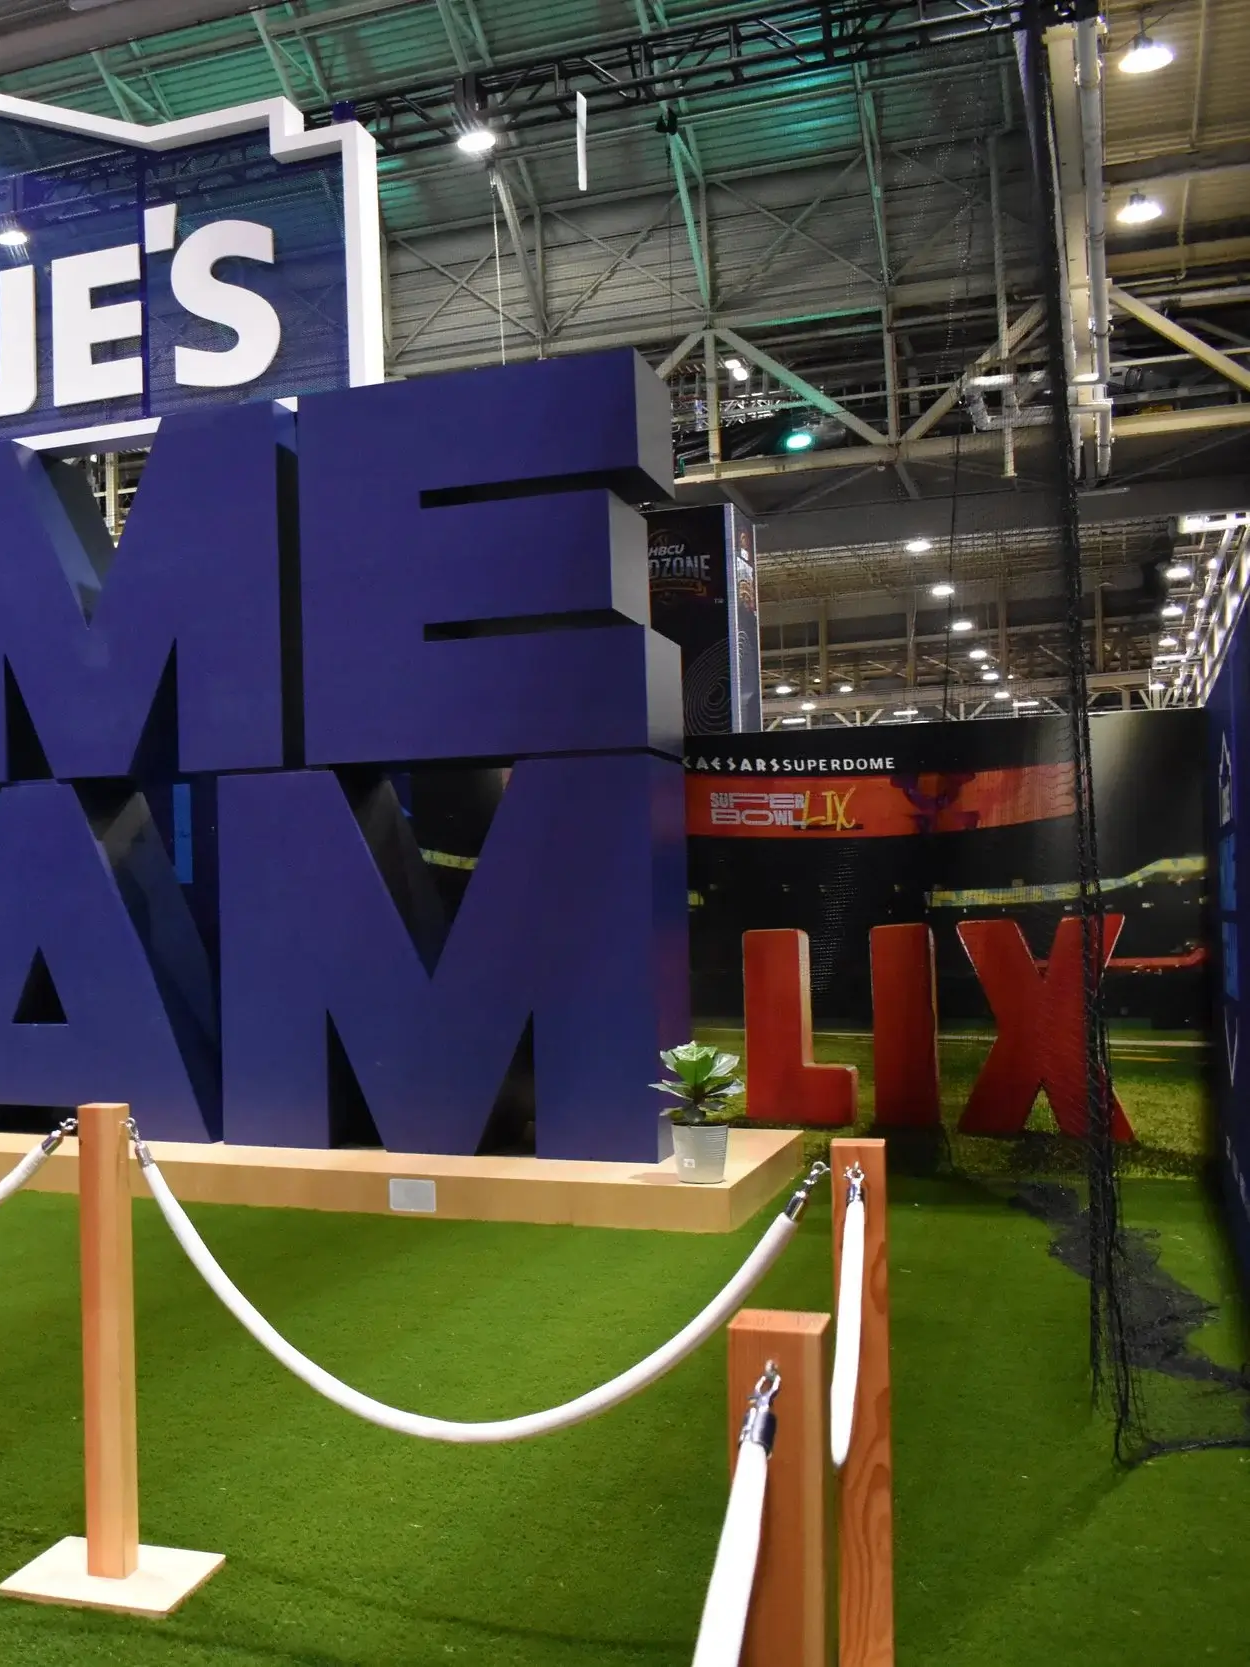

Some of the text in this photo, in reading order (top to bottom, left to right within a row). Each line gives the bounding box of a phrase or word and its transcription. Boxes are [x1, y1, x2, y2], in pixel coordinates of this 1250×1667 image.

[649, 543, 685, 557] HBCU
[648, 554, 711, 582] DZONE
[681, 756, 896, 772] CAESARS SUPERDOME
[710, 791, 806, 809] SUPER
[711, 784, 856, 832] BOWL LIX
[743, 914, 1137, 1143] LIX
